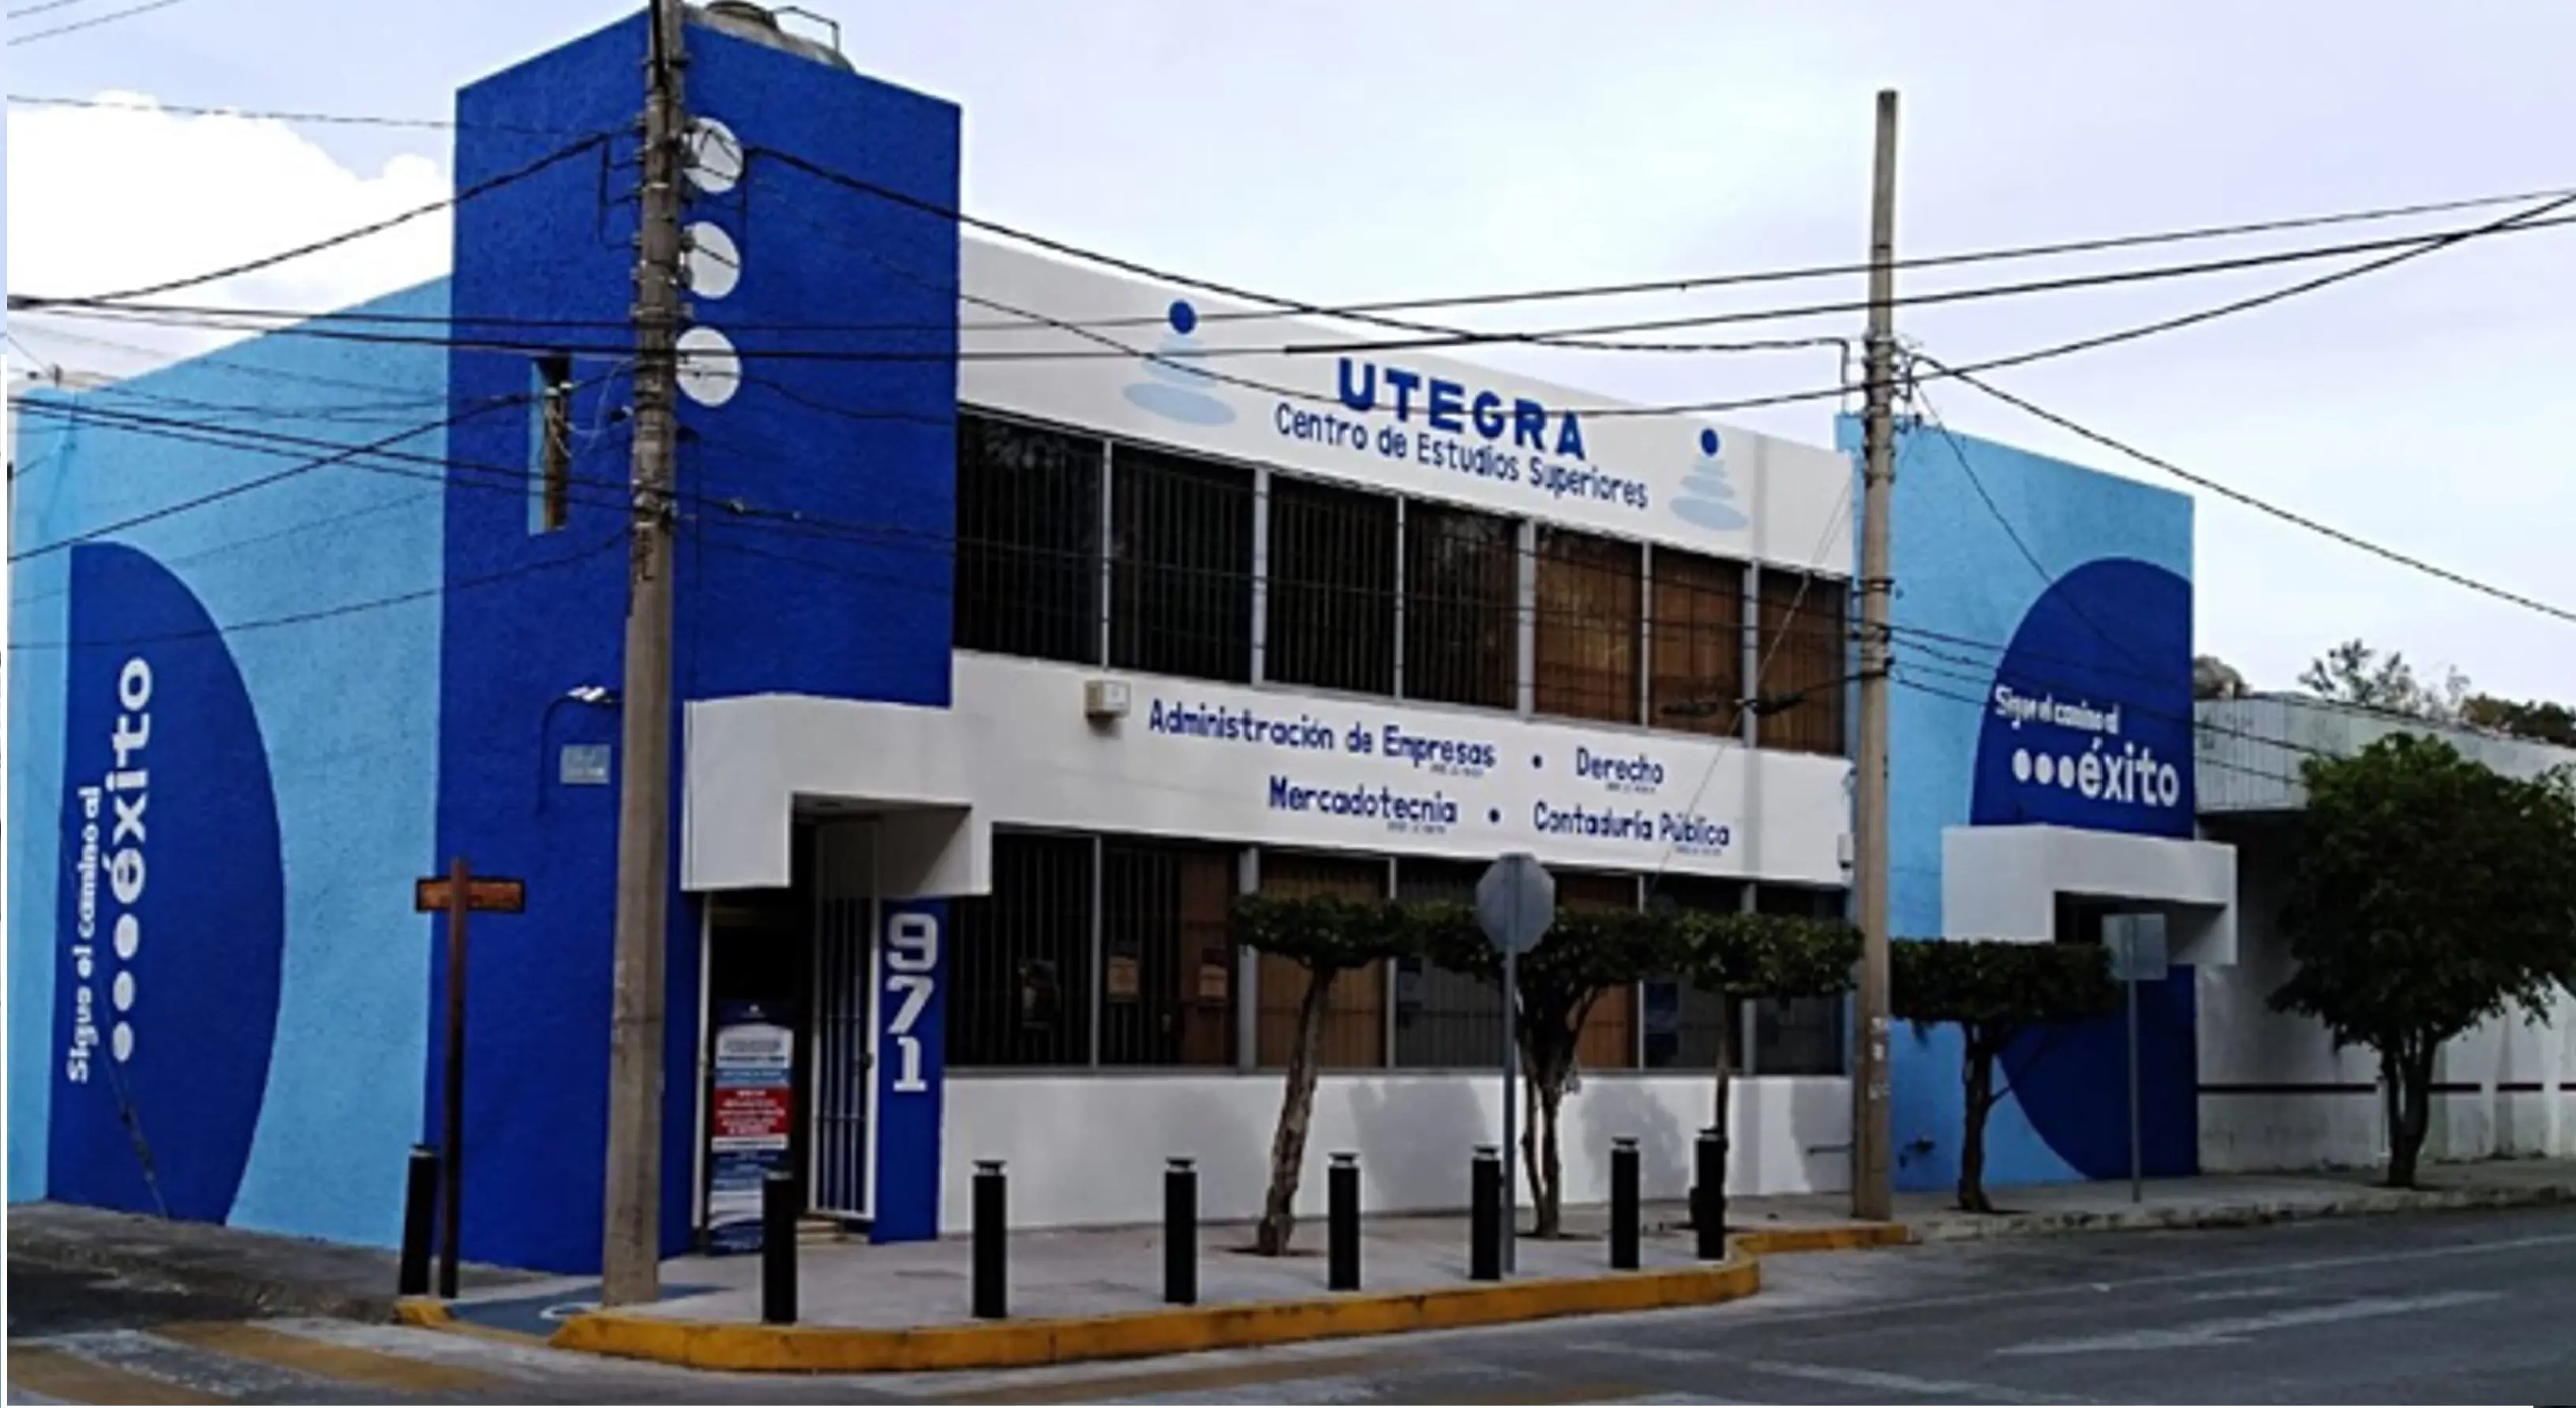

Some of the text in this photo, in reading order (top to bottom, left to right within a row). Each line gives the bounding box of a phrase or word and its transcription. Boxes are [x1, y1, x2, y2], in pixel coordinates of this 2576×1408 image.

[1275, 402, 1648, 508] Centro de Estudios Superiores
[1337, 358, 1585, 459] UTEGRA
[101, 657, 154, 904] éxito
[1148, 698, 1664, 785] Administración de Empresas Derecho
[2077, 736, 2180, 808] éxito
[1268, 774, 1730, 848] Mercadotecnia Contaduría Pública
[66, 786, 103, 1083] Sigue el camino al
[887, 912, 938, 1092] 971
